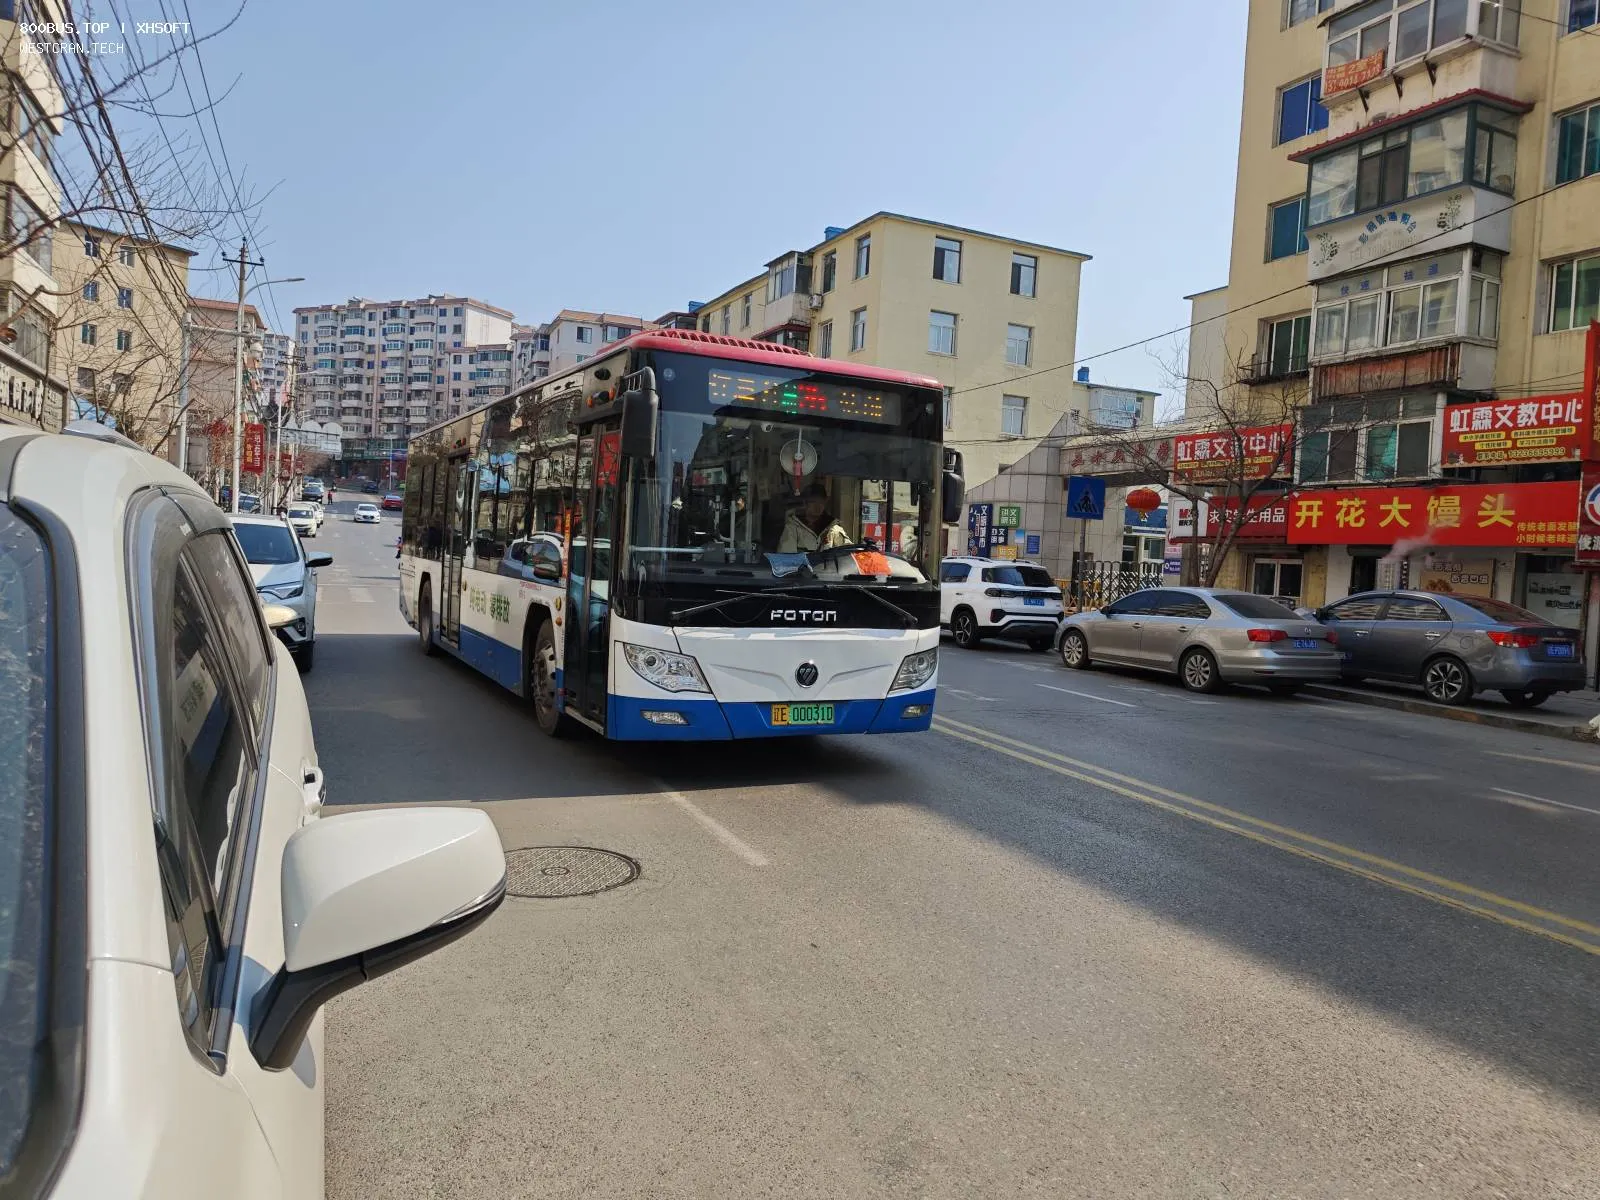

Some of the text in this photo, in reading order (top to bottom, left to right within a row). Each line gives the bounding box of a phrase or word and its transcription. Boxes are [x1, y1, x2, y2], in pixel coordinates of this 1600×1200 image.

[1295, 493, 1516, 528] 开花大馒头
[771, 609, 838, 622] FOTON
